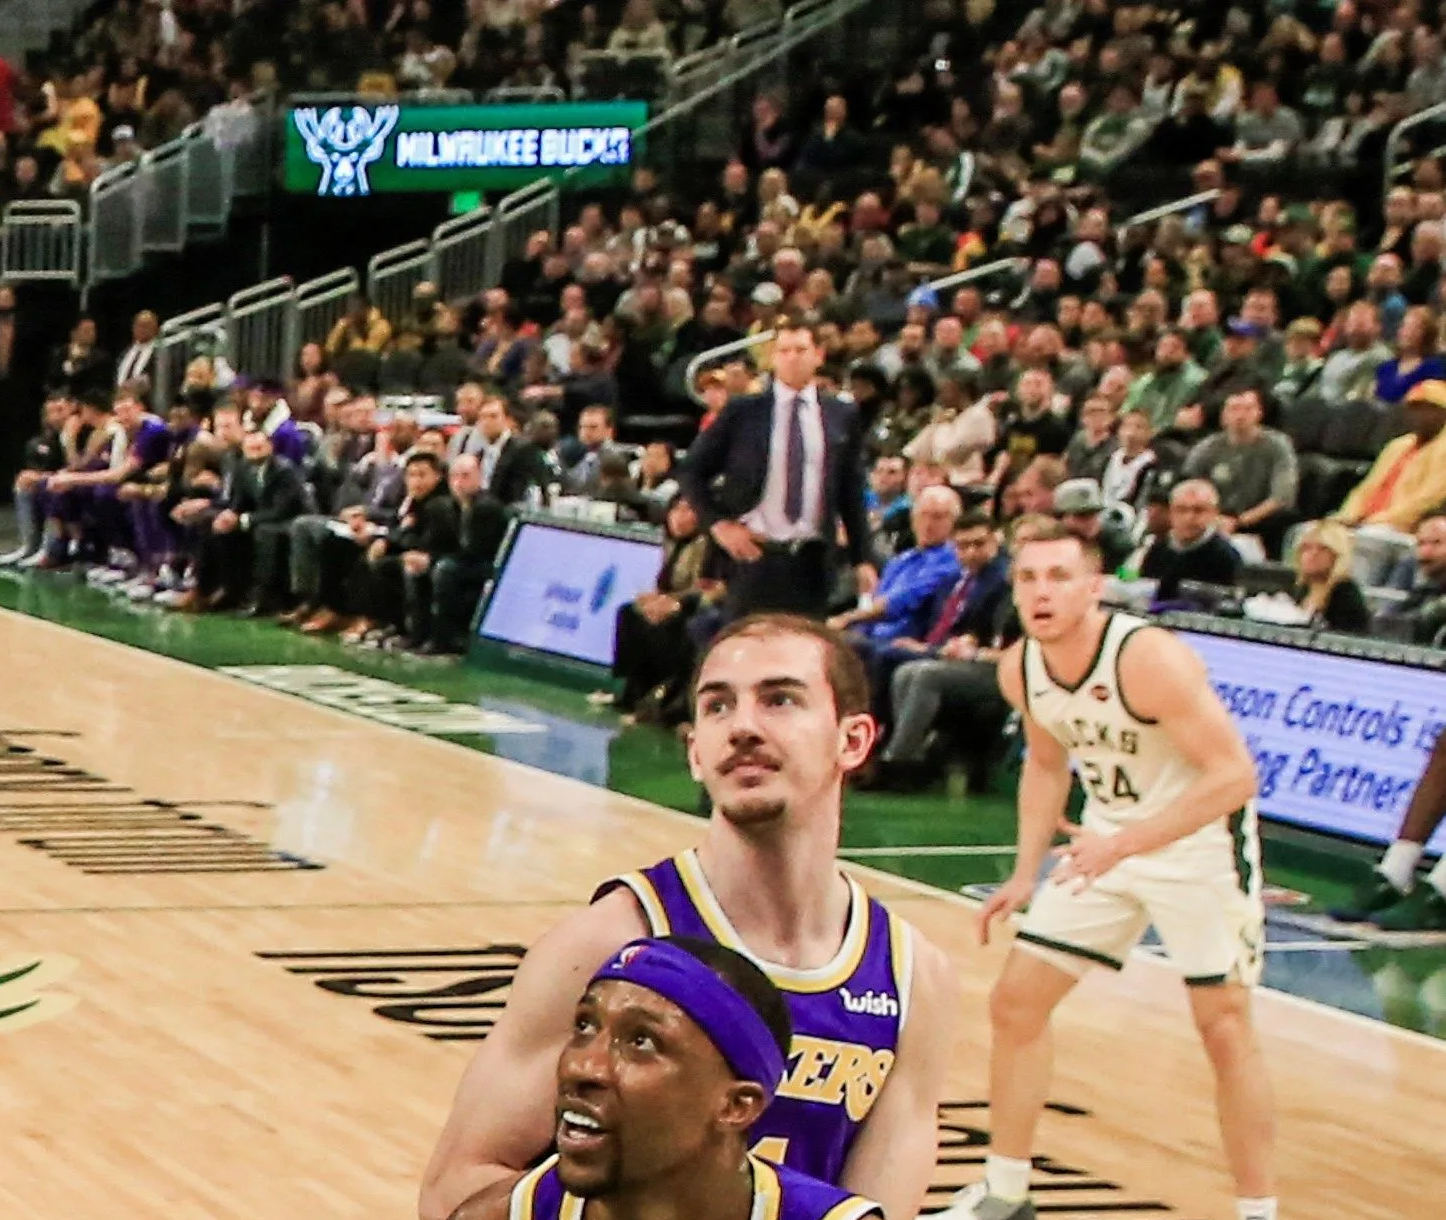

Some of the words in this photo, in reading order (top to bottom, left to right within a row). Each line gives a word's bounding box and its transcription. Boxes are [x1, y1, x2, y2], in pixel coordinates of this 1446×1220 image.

[396, 130, 538, 167] MILWAUKEE
[540, 128, 629, 165] BUCKS
[1284, 685, 1411, 747] Controls
[1291, 748, 1411, 808] Partner
[838, 987, 898, 1017] wish
